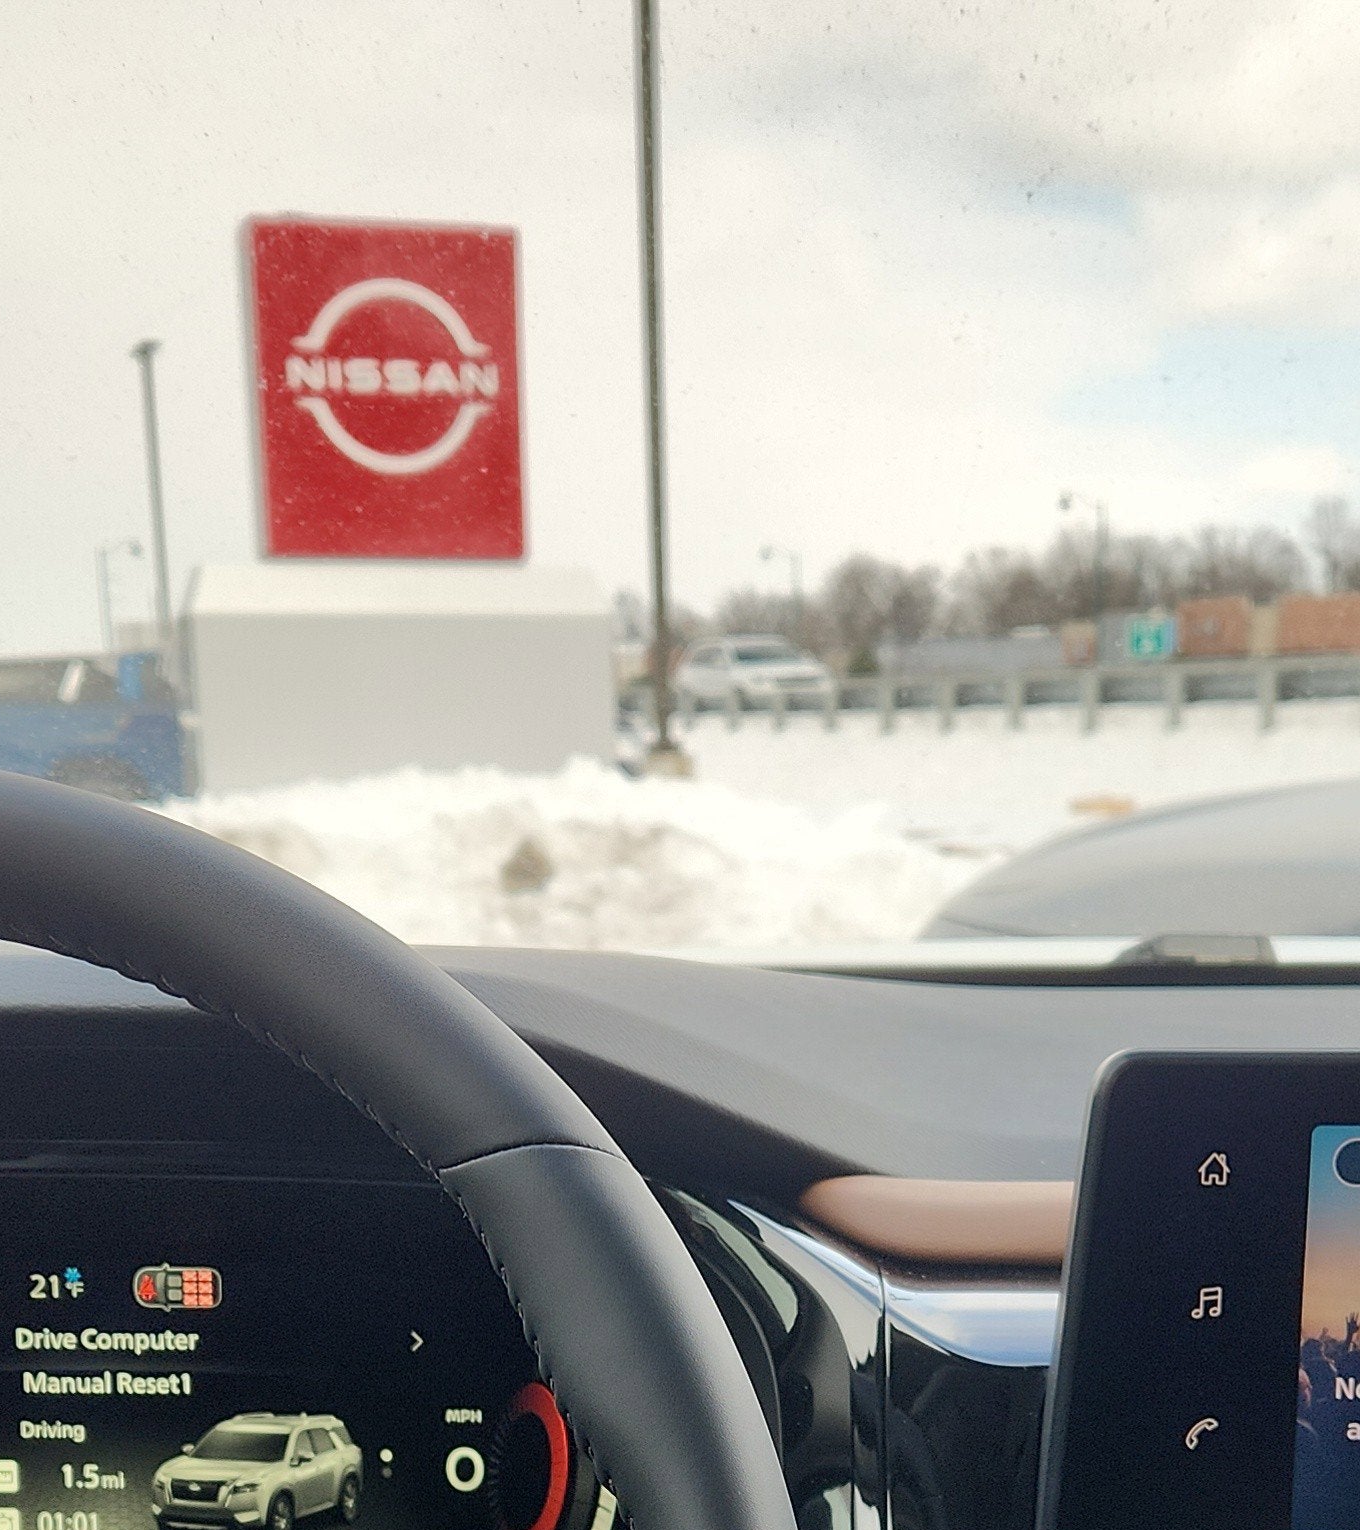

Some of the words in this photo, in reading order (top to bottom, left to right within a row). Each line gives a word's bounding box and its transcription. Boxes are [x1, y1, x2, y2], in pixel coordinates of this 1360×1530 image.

[285, 355, 499, 398] NISSAN
[15, 1327, 77, 1350] Drive
[80, 1327, 199, 1355] Computer
[22, 1371, 112, 1395] Manual
[446, 1408, 482, 1424] MPH
[20, 1420, 85, 1443] Driving
